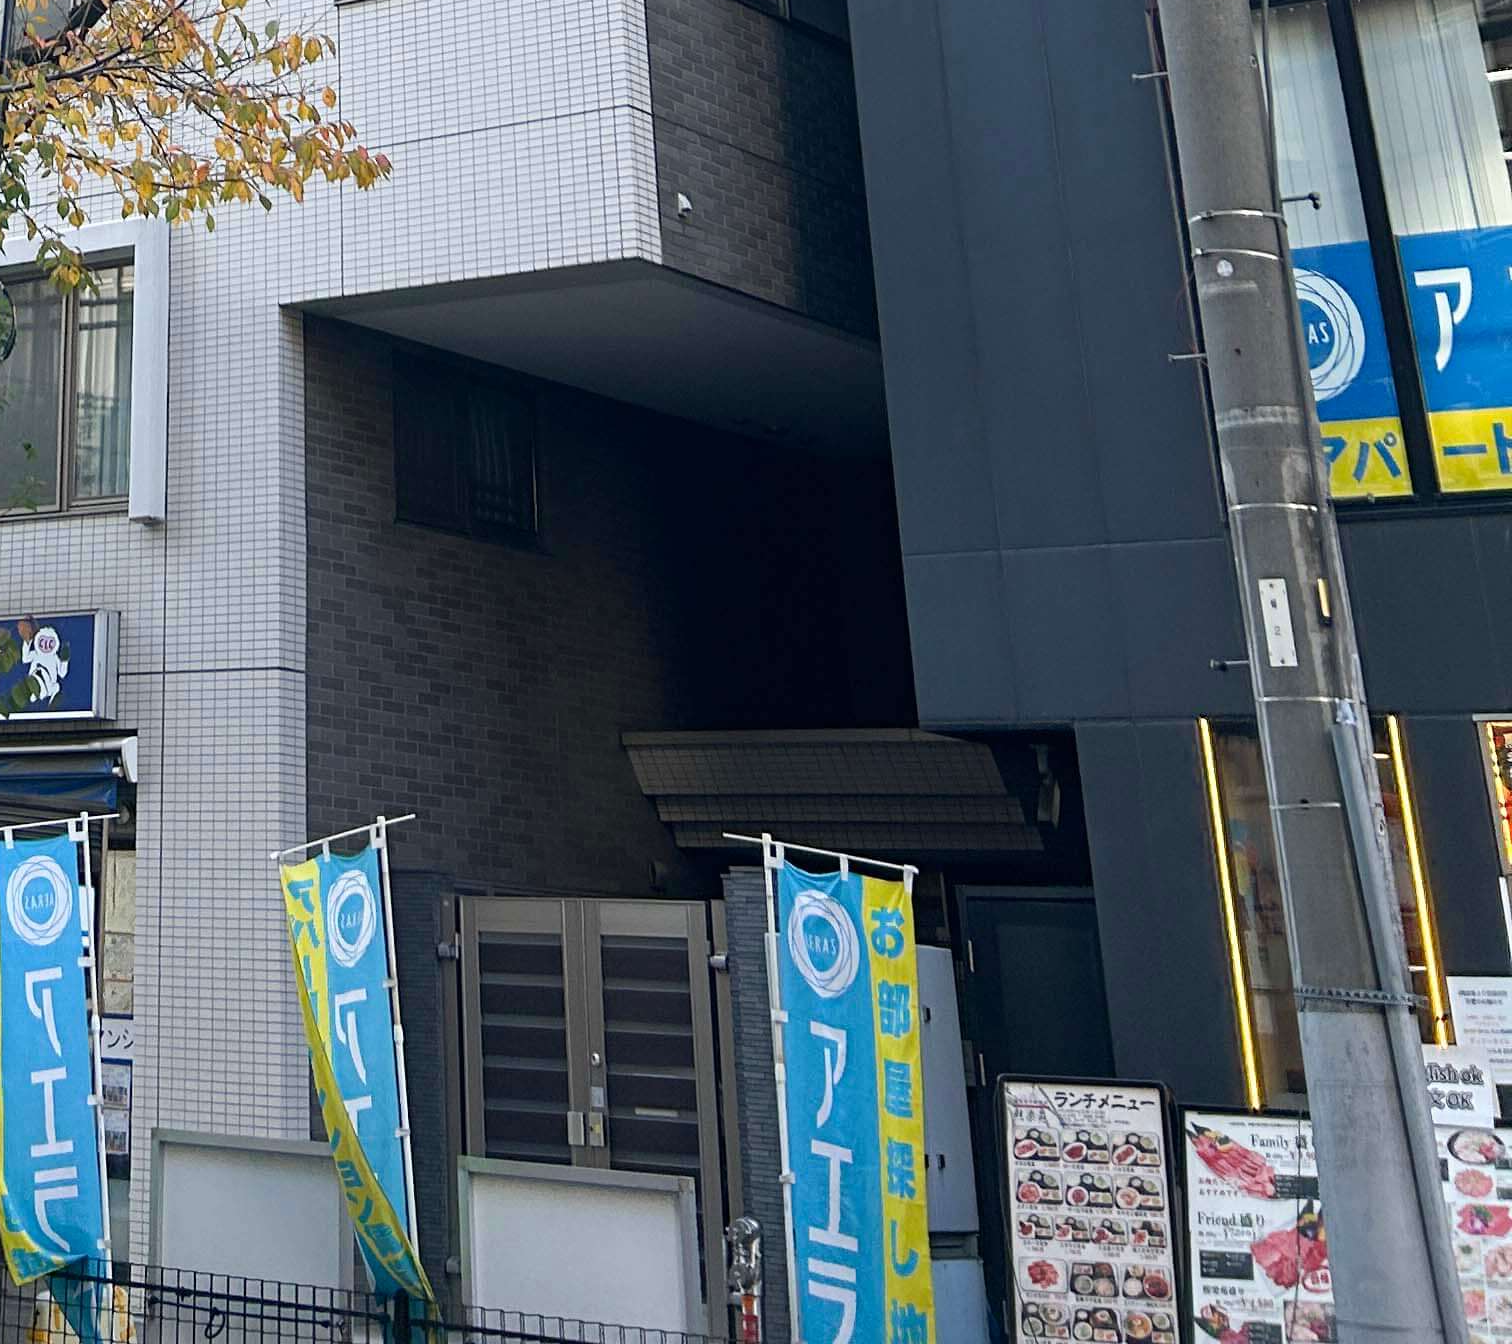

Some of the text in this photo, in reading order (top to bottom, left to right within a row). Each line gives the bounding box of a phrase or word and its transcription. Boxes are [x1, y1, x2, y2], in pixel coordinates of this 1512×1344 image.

[1054, 1091, 1155, 1112] ランチメニュー
